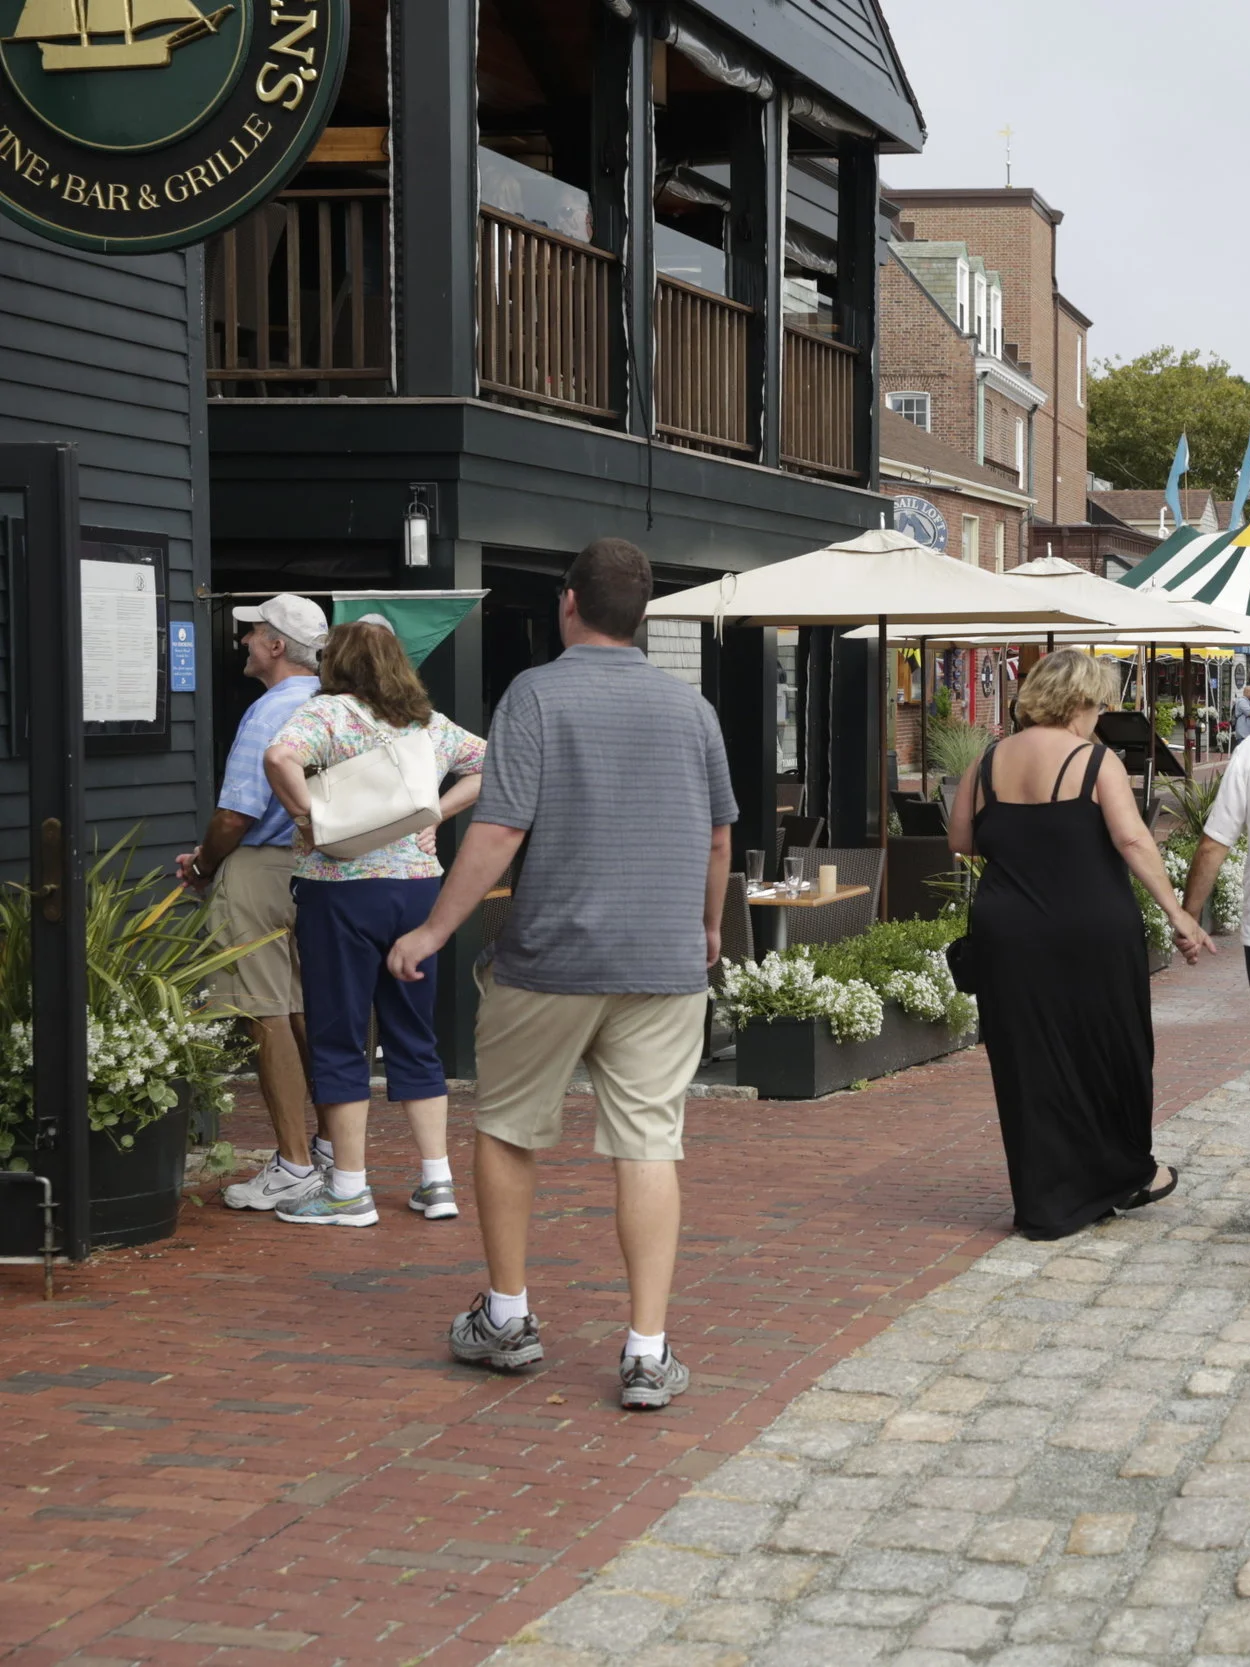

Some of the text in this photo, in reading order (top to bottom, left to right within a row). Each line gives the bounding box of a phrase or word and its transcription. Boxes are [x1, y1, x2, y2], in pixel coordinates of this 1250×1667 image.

[256, 0, 317, 111] N'S
[0, 112, 273, 211] INE BAR & GRILLE
[921, 502, 946, 531] LOFT
